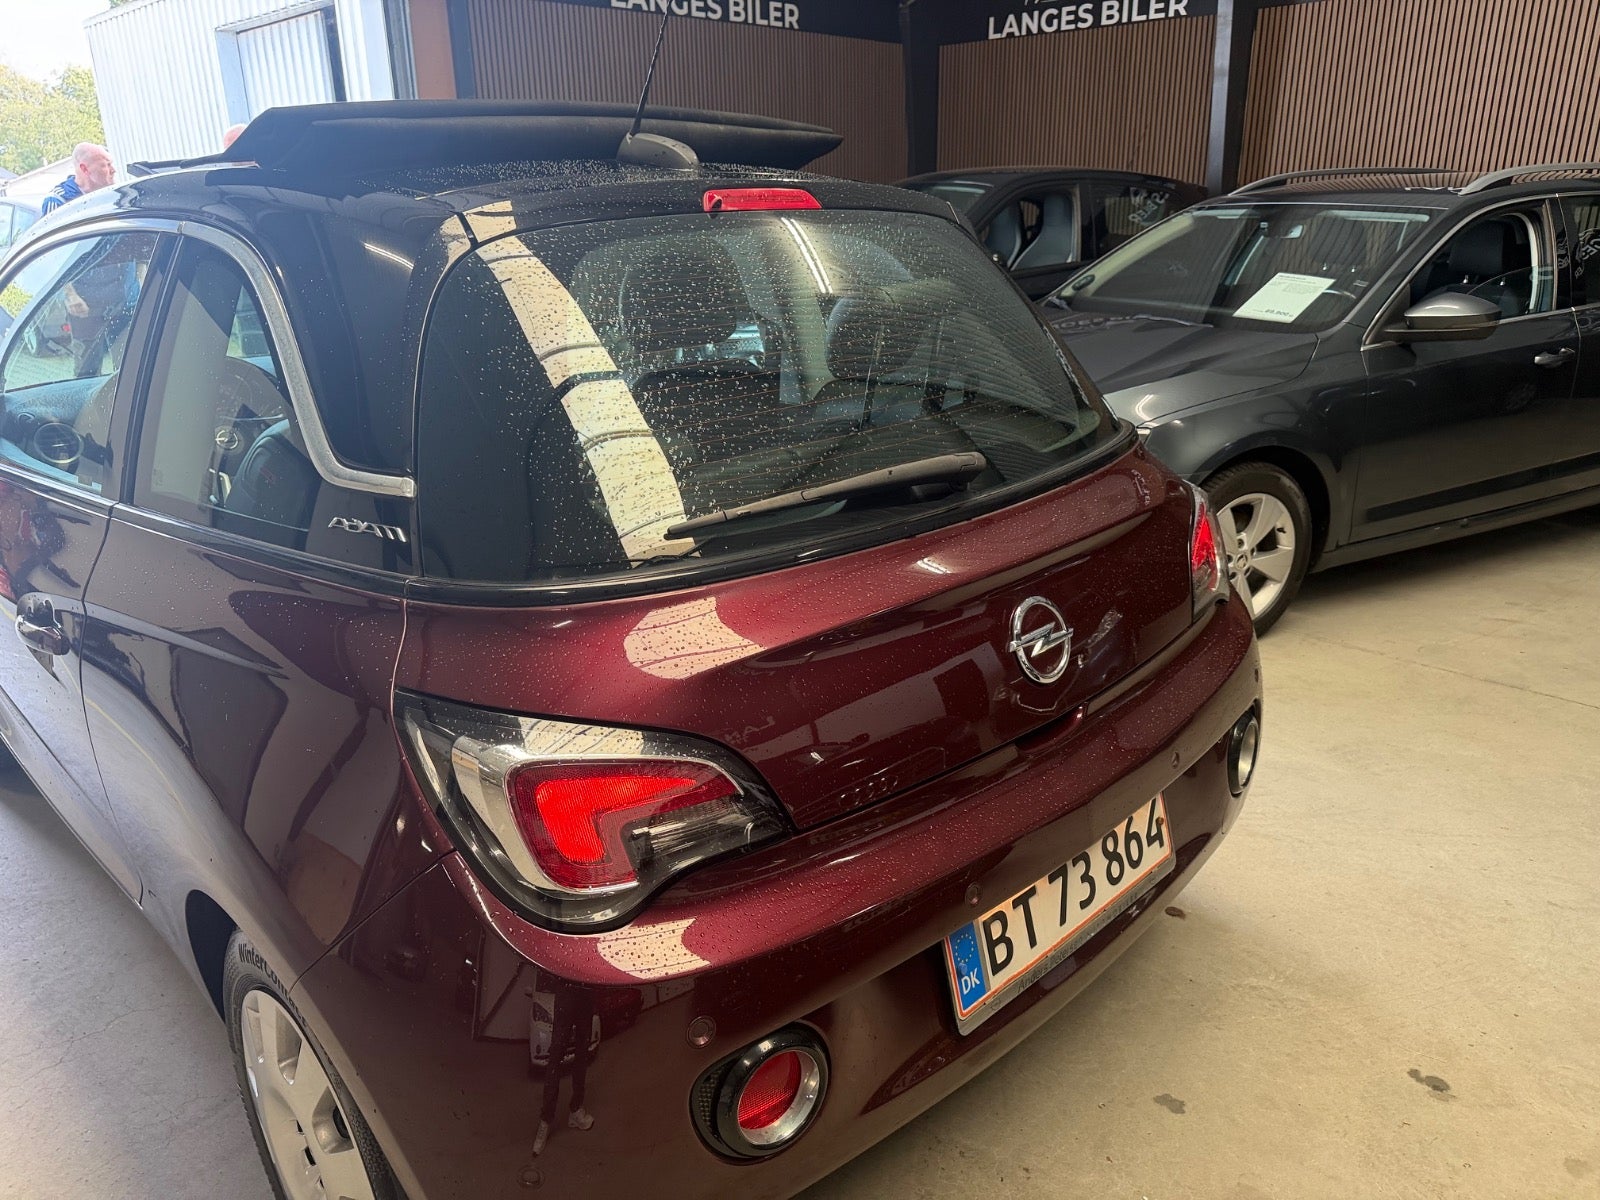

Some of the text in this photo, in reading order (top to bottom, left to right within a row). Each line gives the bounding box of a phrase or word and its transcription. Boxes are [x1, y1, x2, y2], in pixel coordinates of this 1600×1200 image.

[729, 0, 800, 29] BILER
[988, 0, 1187, 39] LANGES BILER
[982, 884, 1037, 977] BT
[1048, 851, 1096, 927] 73
[1101, 798, 1164, 886] 864
[961, 971, 980, 995] DK
